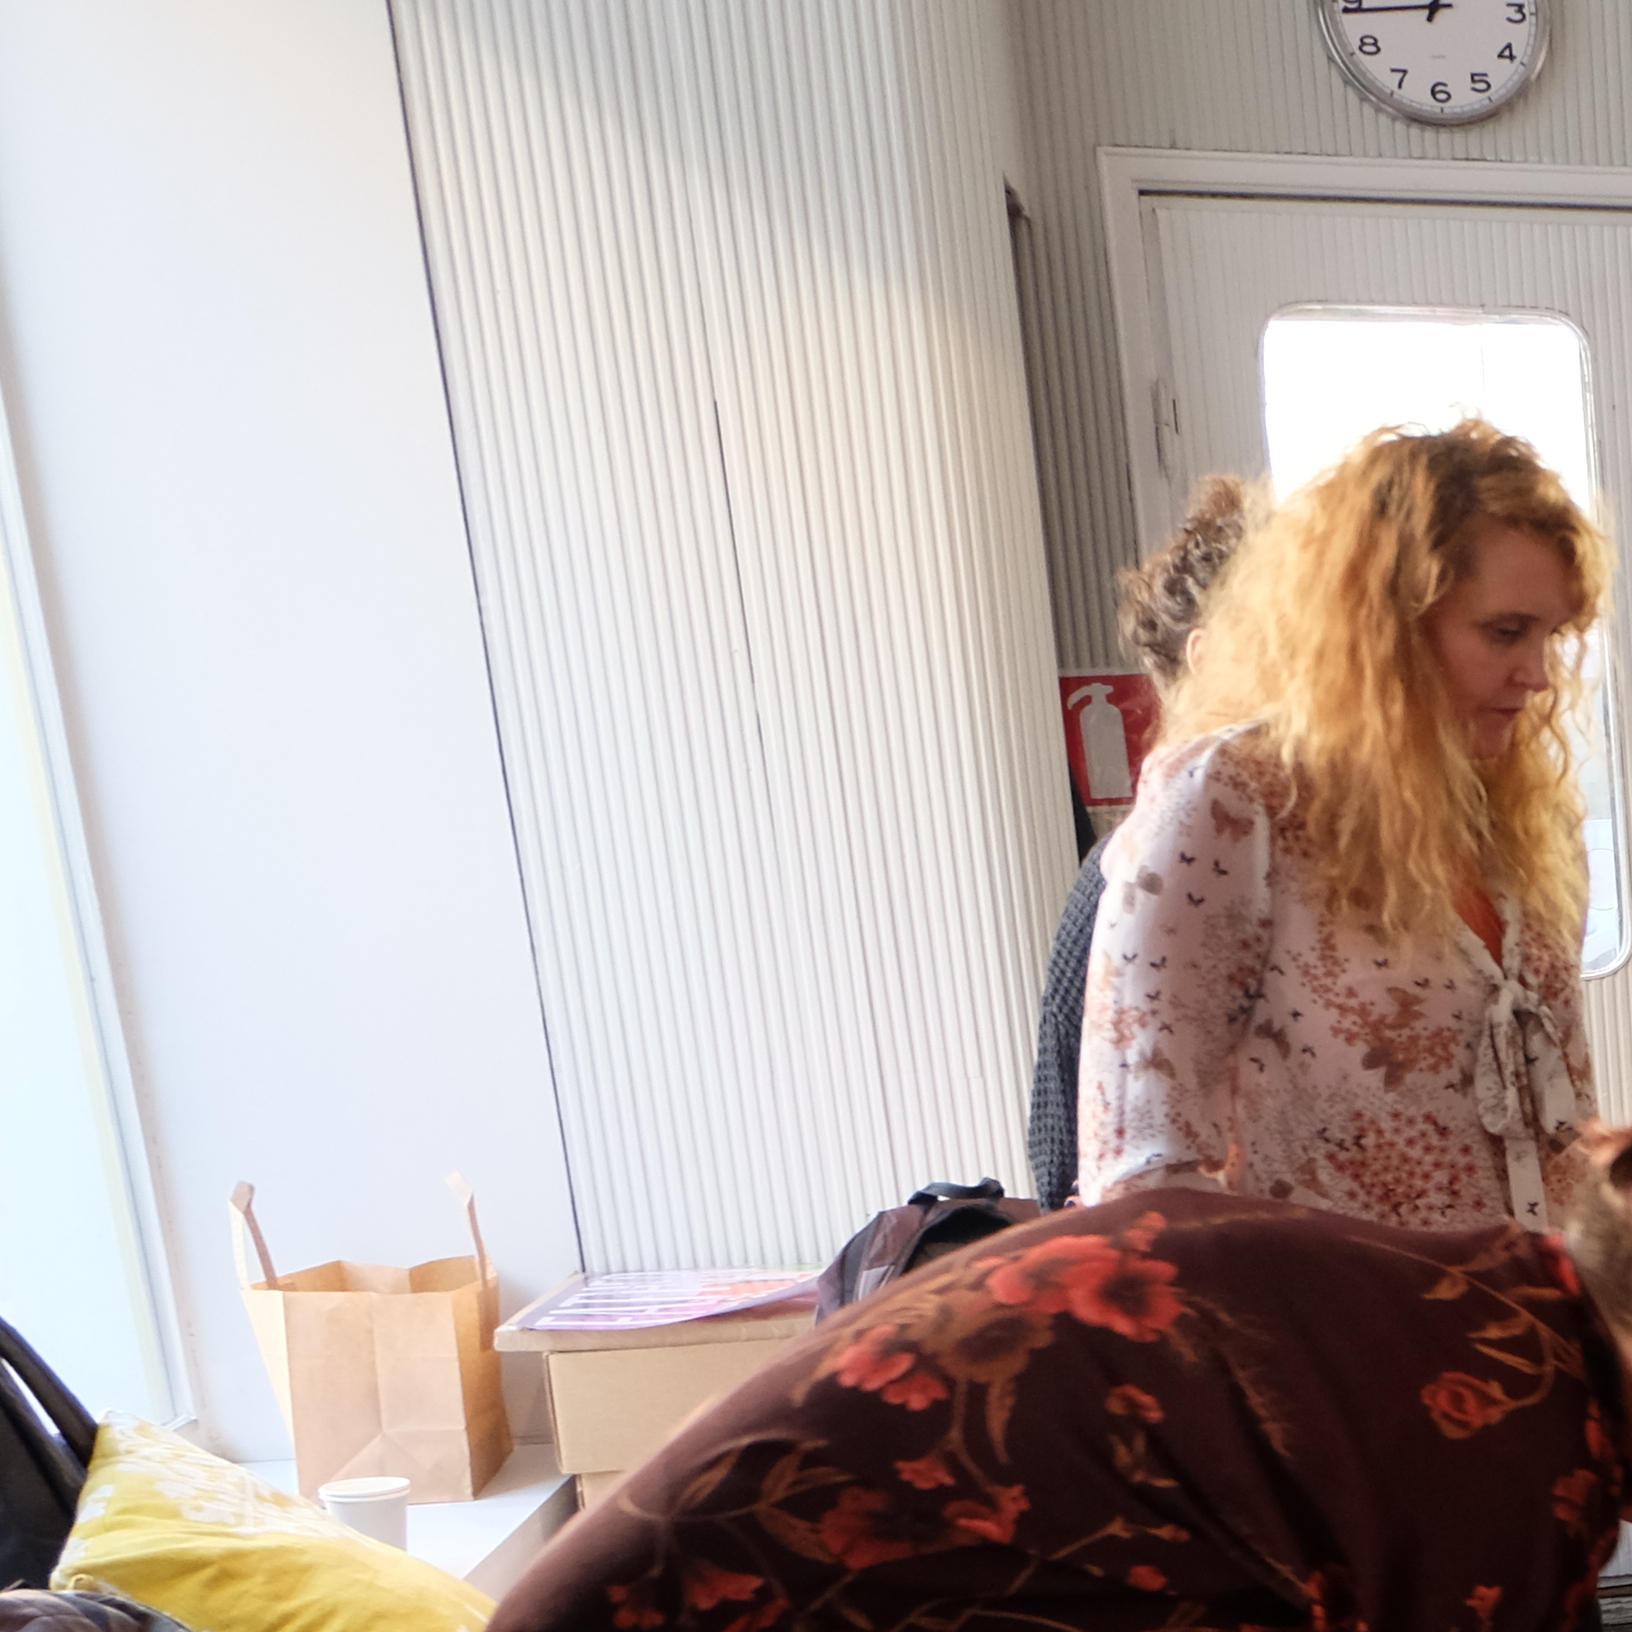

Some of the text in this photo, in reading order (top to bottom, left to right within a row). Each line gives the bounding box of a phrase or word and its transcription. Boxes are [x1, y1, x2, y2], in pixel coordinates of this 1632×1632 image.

[1506, 2, 1527, 23] 3
[1358, 35, 1381, 55] 8
[1497, 42, 1516, 61] 4
[1390, 68, 1408, 89] 7
[1470, 72, 1492, 92] 5
[1431, 82, 1451, 102] 6
